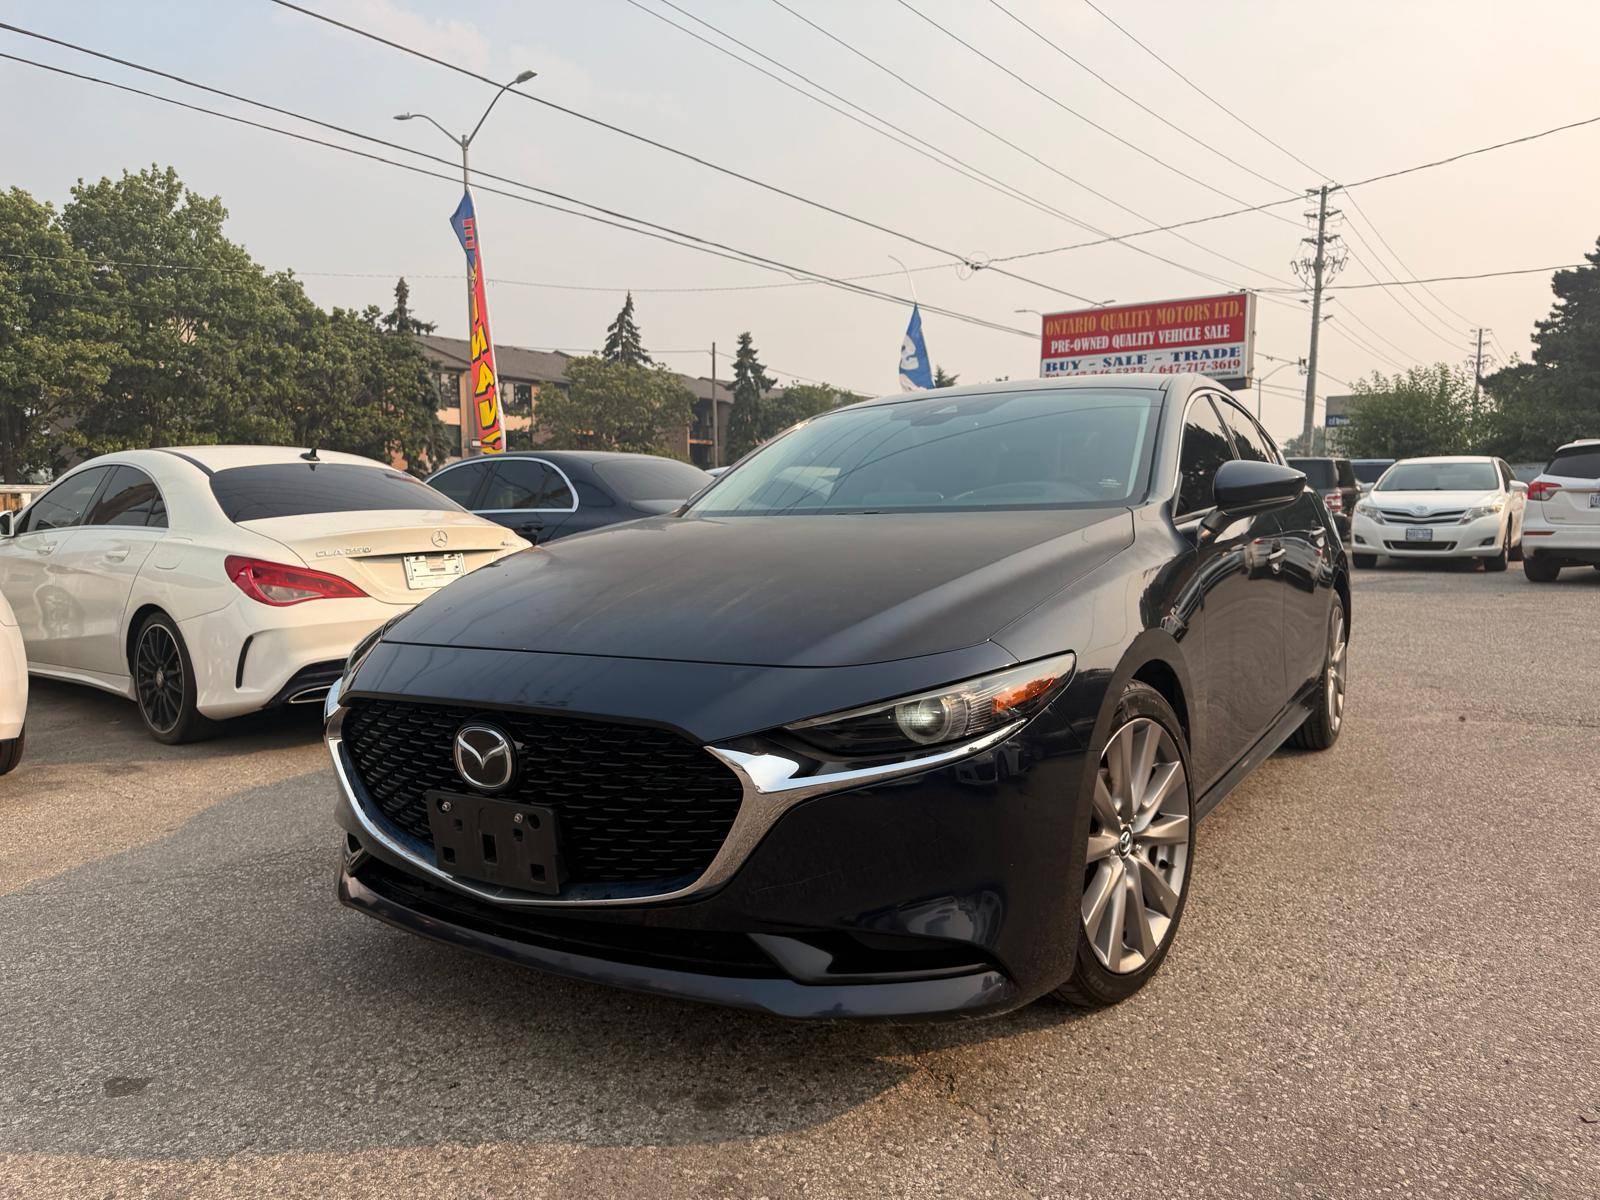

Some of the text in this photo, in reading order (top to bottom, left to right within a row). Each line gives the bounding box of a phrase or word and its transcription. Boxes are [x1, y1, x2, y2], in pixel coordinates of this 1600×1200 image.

[1046, 300, 1243, 336] ONTARIO QUALITY MOTORS LTD.
[1051, 323, 1231, 354] PRE-OWNED QUALITY VEHICLE SALE
[1045, 360, 1081, 372] BUY
[1102, 353, 1148, 368] SALE
[1170, 346, 1240, 362] TRADE
[1158, 359, 1241, 375] 647-717-3619
[315, 548, 343, 558] CLA
